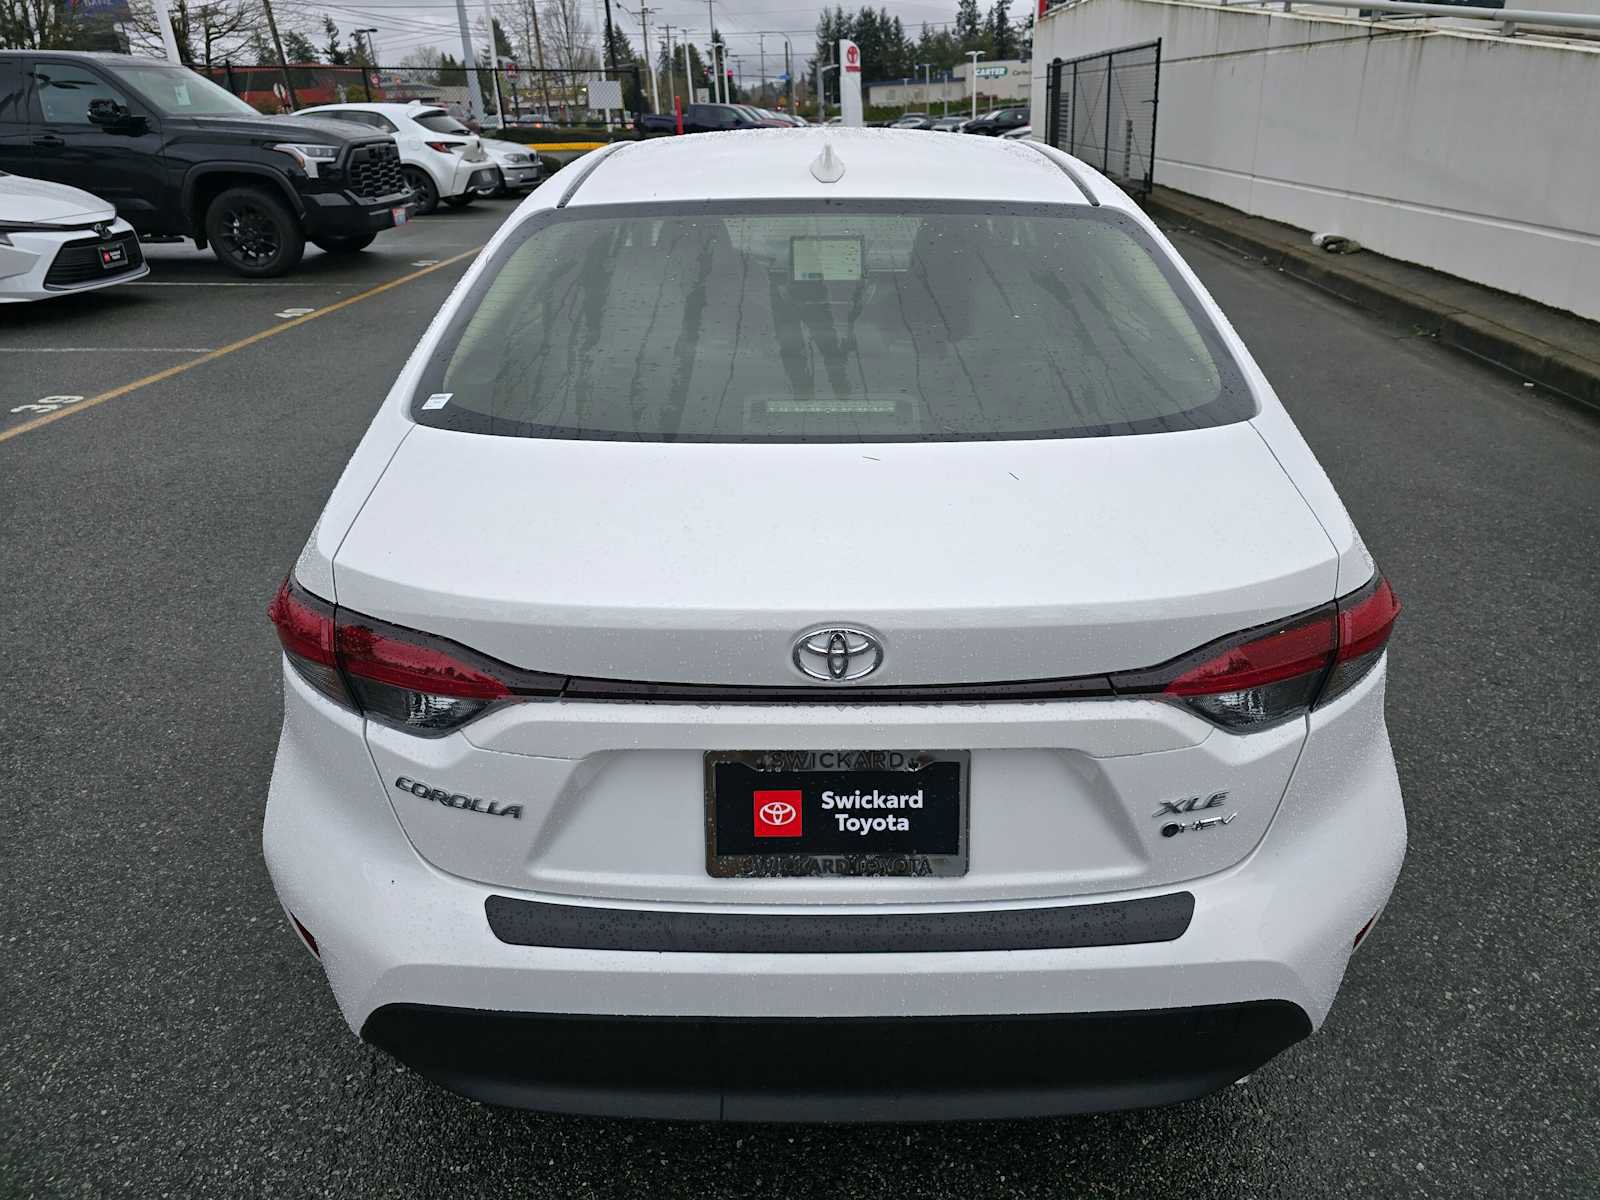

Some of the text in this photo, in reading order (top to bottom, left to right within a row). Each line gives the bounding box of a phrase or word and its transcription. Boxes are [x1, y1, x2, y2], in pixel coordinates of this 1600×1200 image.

[10, 395, 84, 414] 39
[771, 751, 905, 769] SWICKARD
[395, 775, 524, 819] COROLLA
[821, 789, 924, 809] Swickard
[1152, 790, 1230, 817] XLE
[834, 813, 910, 836] Toyota
